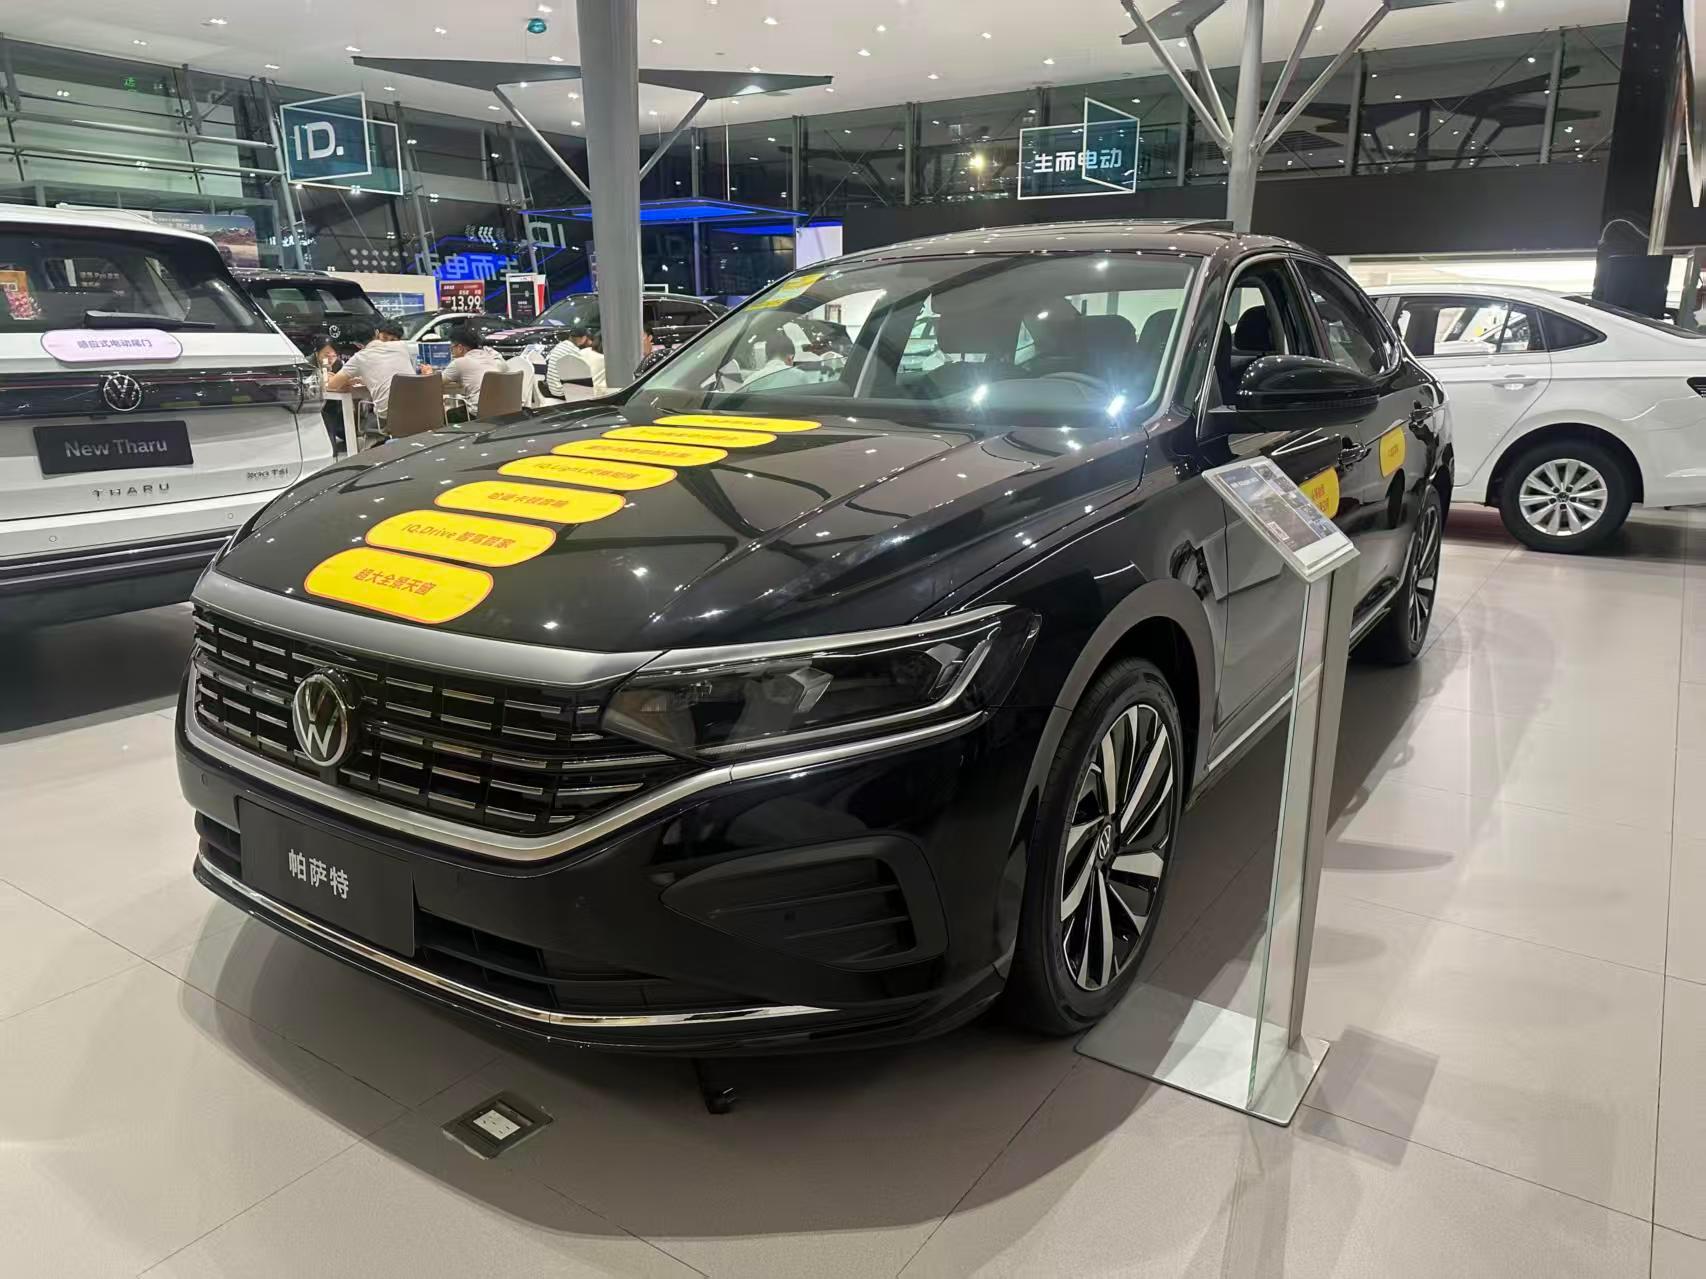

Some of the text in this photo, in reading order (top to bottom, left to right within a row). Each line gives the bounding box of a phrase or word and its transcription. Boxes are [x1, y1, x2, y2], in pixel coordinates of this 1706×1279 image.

[293, 121, 344, 161] ID.
[1033, 147, 1123, 174] 生而电动
[65, 437, 168, 458] New Tharu
[92, 482, 170, 498] THARU
[351, 567, 437, 597] 超大全景天窗
[287, 848, 350, 900] 帕萨特
